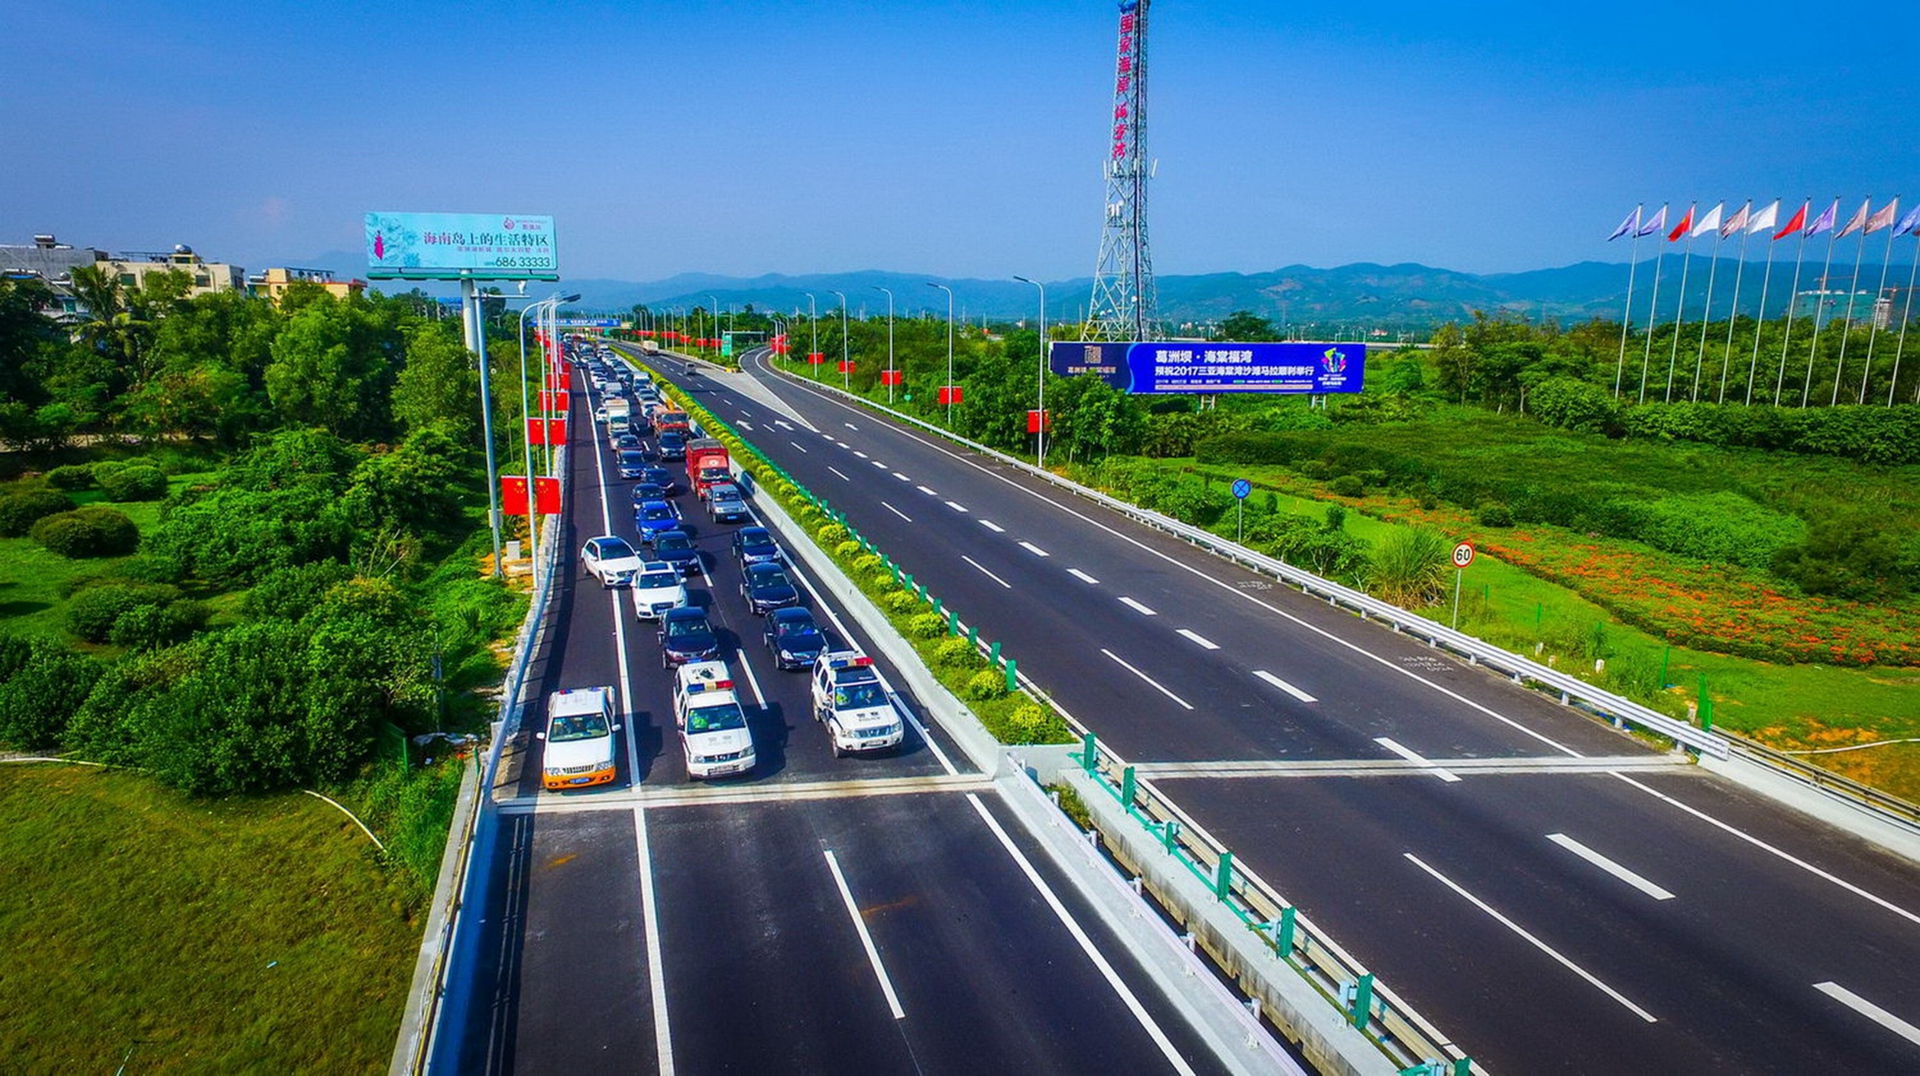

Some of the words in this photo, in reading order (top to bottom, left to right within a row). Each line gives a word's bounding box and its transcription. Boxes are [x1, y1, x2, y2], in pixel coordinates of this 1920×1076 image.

[424, 231, 548, 246] 海南岛上的生活特区
[495, 257, 516, 267] 686
[519, 257, 550, 267] 33333
[1456, 548, 1471, 561] 60
